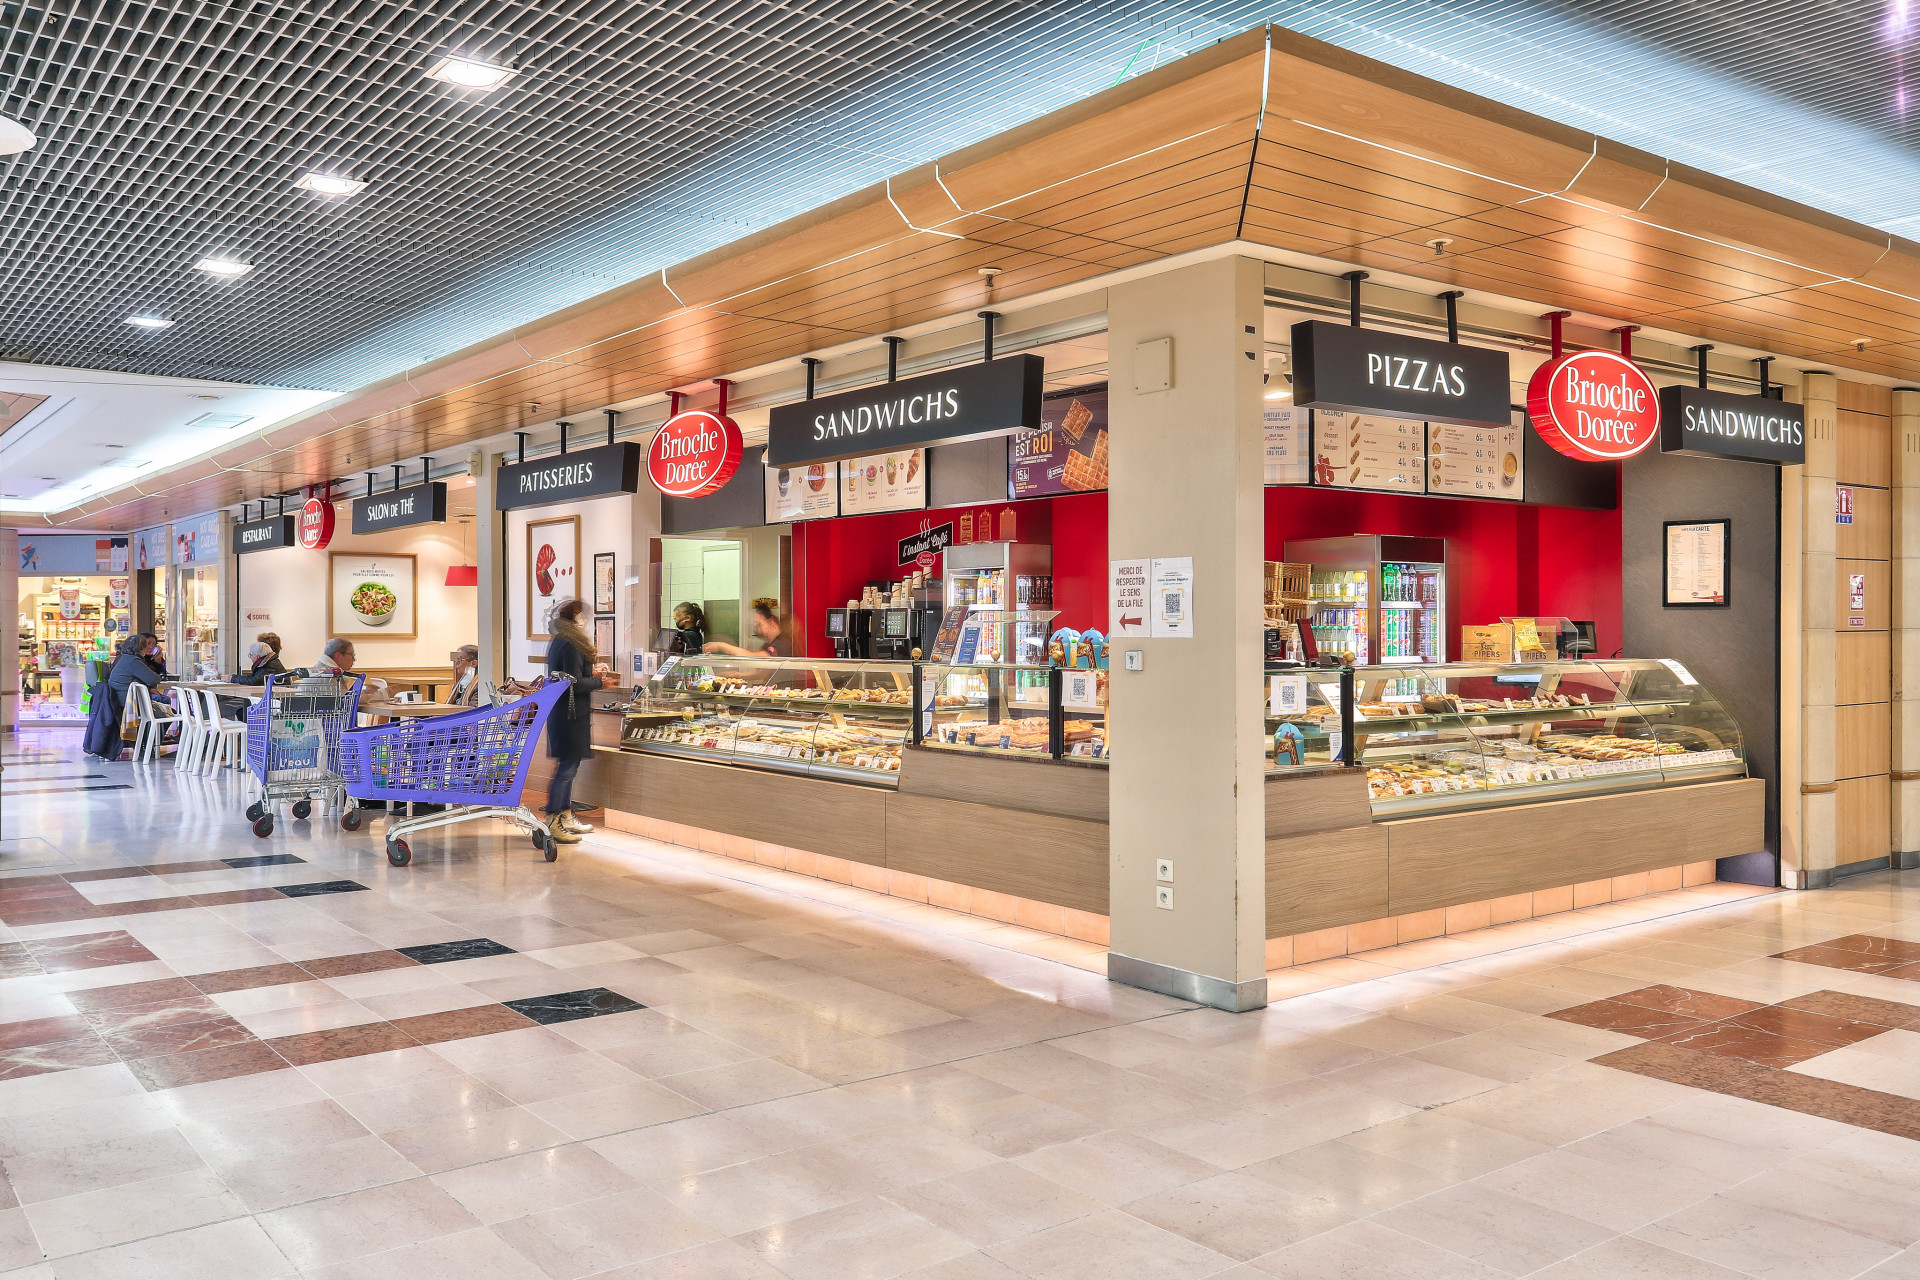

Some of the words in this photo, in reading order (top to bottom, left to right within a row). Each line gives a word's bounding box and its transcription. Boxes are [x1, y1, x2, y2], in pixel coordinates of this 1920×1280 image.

[1368, 353, 1465, 396] PIZZAS
[1565, 366, 1646, 413] Brioche
[813, 388, 959, 441] SANDWICHS
[1576, 410, 1636, 445] Dorée
[1685, 405, 1802, 445] SANDWICHS
[660, 422, 718, 460] Brioche
[1016, 432, 1026, 443] LE
[1016, 440, 1031, 457] EST
[1033, 431, 1053, 454] ROI
[520, 462, 593, 493] PATISSERIES
[664, 454, 708, 485] Dorée
[302, 505, 322, 527] Brioche
[367, 503, 389, 521] SALON
[400, 493, 414, 515] THÉ
[242, 526, 272, 543] RESTAURANT
[1115, 577, 1146, 586] RESPECTER
[1118, 566, 1135, 575] MERCI
[1136, 566, 1143, 574] DE
[1117, 600, 1125, 608] DE
[1125, 599, 1132, 608] LA
[1132, 599, 1144, 607] FILE
[1119, 589, 1127, 597] LE
[1127, 588, 1141, 597] SENS
[1526, 652, 1547, 660] PIPERS
